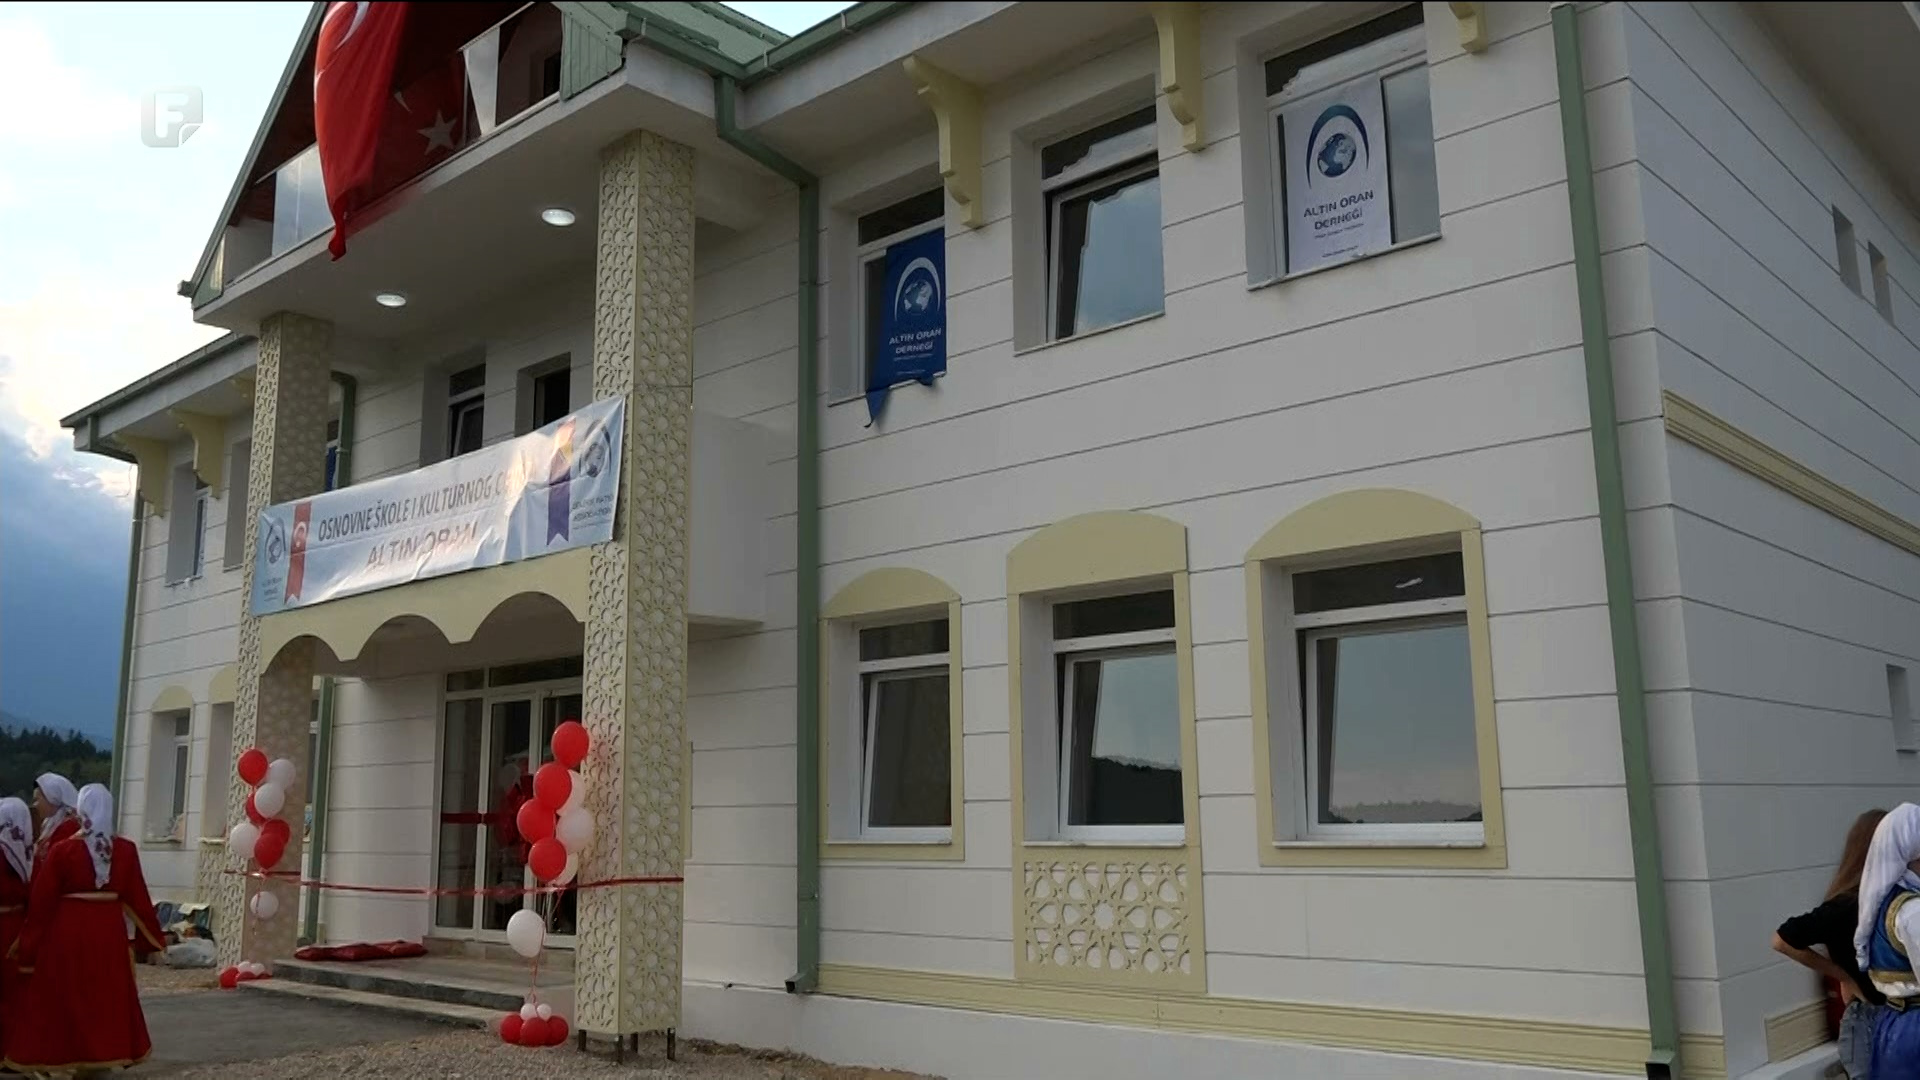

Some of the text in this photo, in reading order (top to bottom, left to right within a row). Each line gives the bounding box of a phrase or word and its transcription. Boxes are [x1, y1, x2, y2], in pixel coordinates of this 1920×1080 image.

[1303, 189, 1374, 218] ALTIN ORAN
[889, 327, 942, 346] ALTIN ORAN
[318, 507, 373, 542] OSNOVNE
[374, 499, 410, 529] ŠKOLE
[411, 497, 417, 520] I
[417, 475, 492, 518] KULTURNOG
[367, 535, 418, 568] ALTIN
